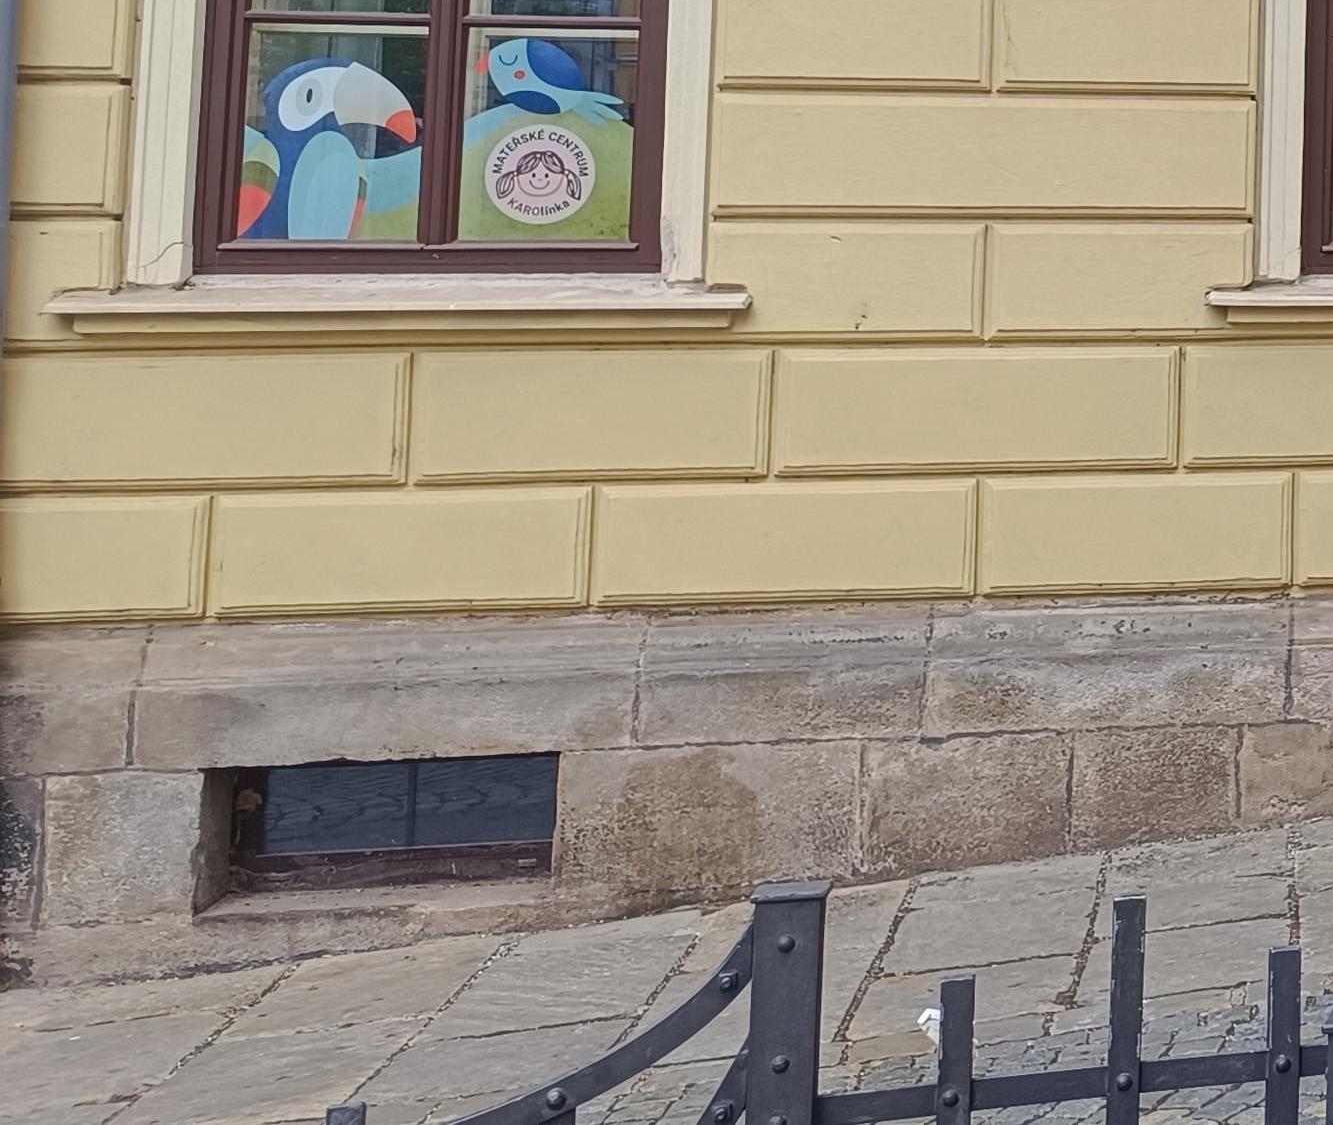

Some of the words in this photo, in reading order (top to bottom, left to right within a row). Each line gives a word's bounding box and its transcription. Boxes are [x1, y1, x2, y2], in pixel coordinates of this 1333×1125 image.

[492, 127, 546, 174] MATEŘSKÉ
[548, 131, 589, 177] CENTRUM
[507, 197, 570, 217] KAROlínka
